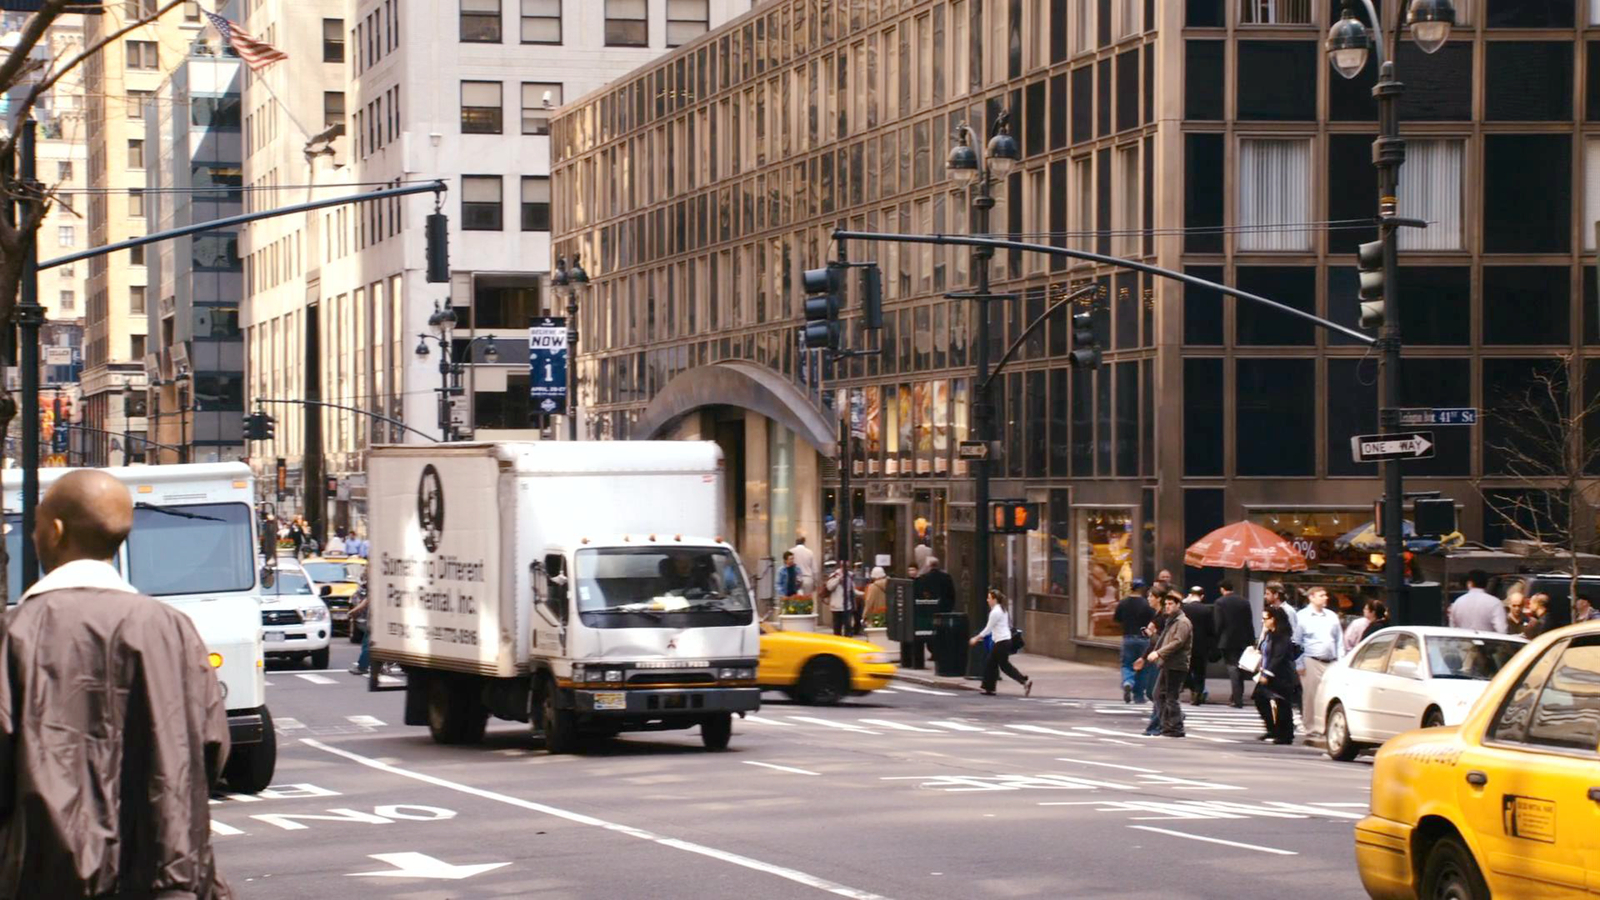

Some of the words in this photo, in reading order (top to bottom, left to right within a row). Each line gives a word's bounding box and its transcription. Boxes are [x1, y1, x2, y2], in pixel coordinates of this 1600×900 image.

[531, 336, 565, 347] NOW
[1461, 411, 1474, 423] St
[1365, 442, 1386, 453] ONE
[1400, 440, 1423, 451] WAY
[1292, 541, 1316, 560] 0%
[382, 552, 435, 585] Sometng
[438, 555, 485, 582] Different
[457, 588, 478, 615] Inc.
